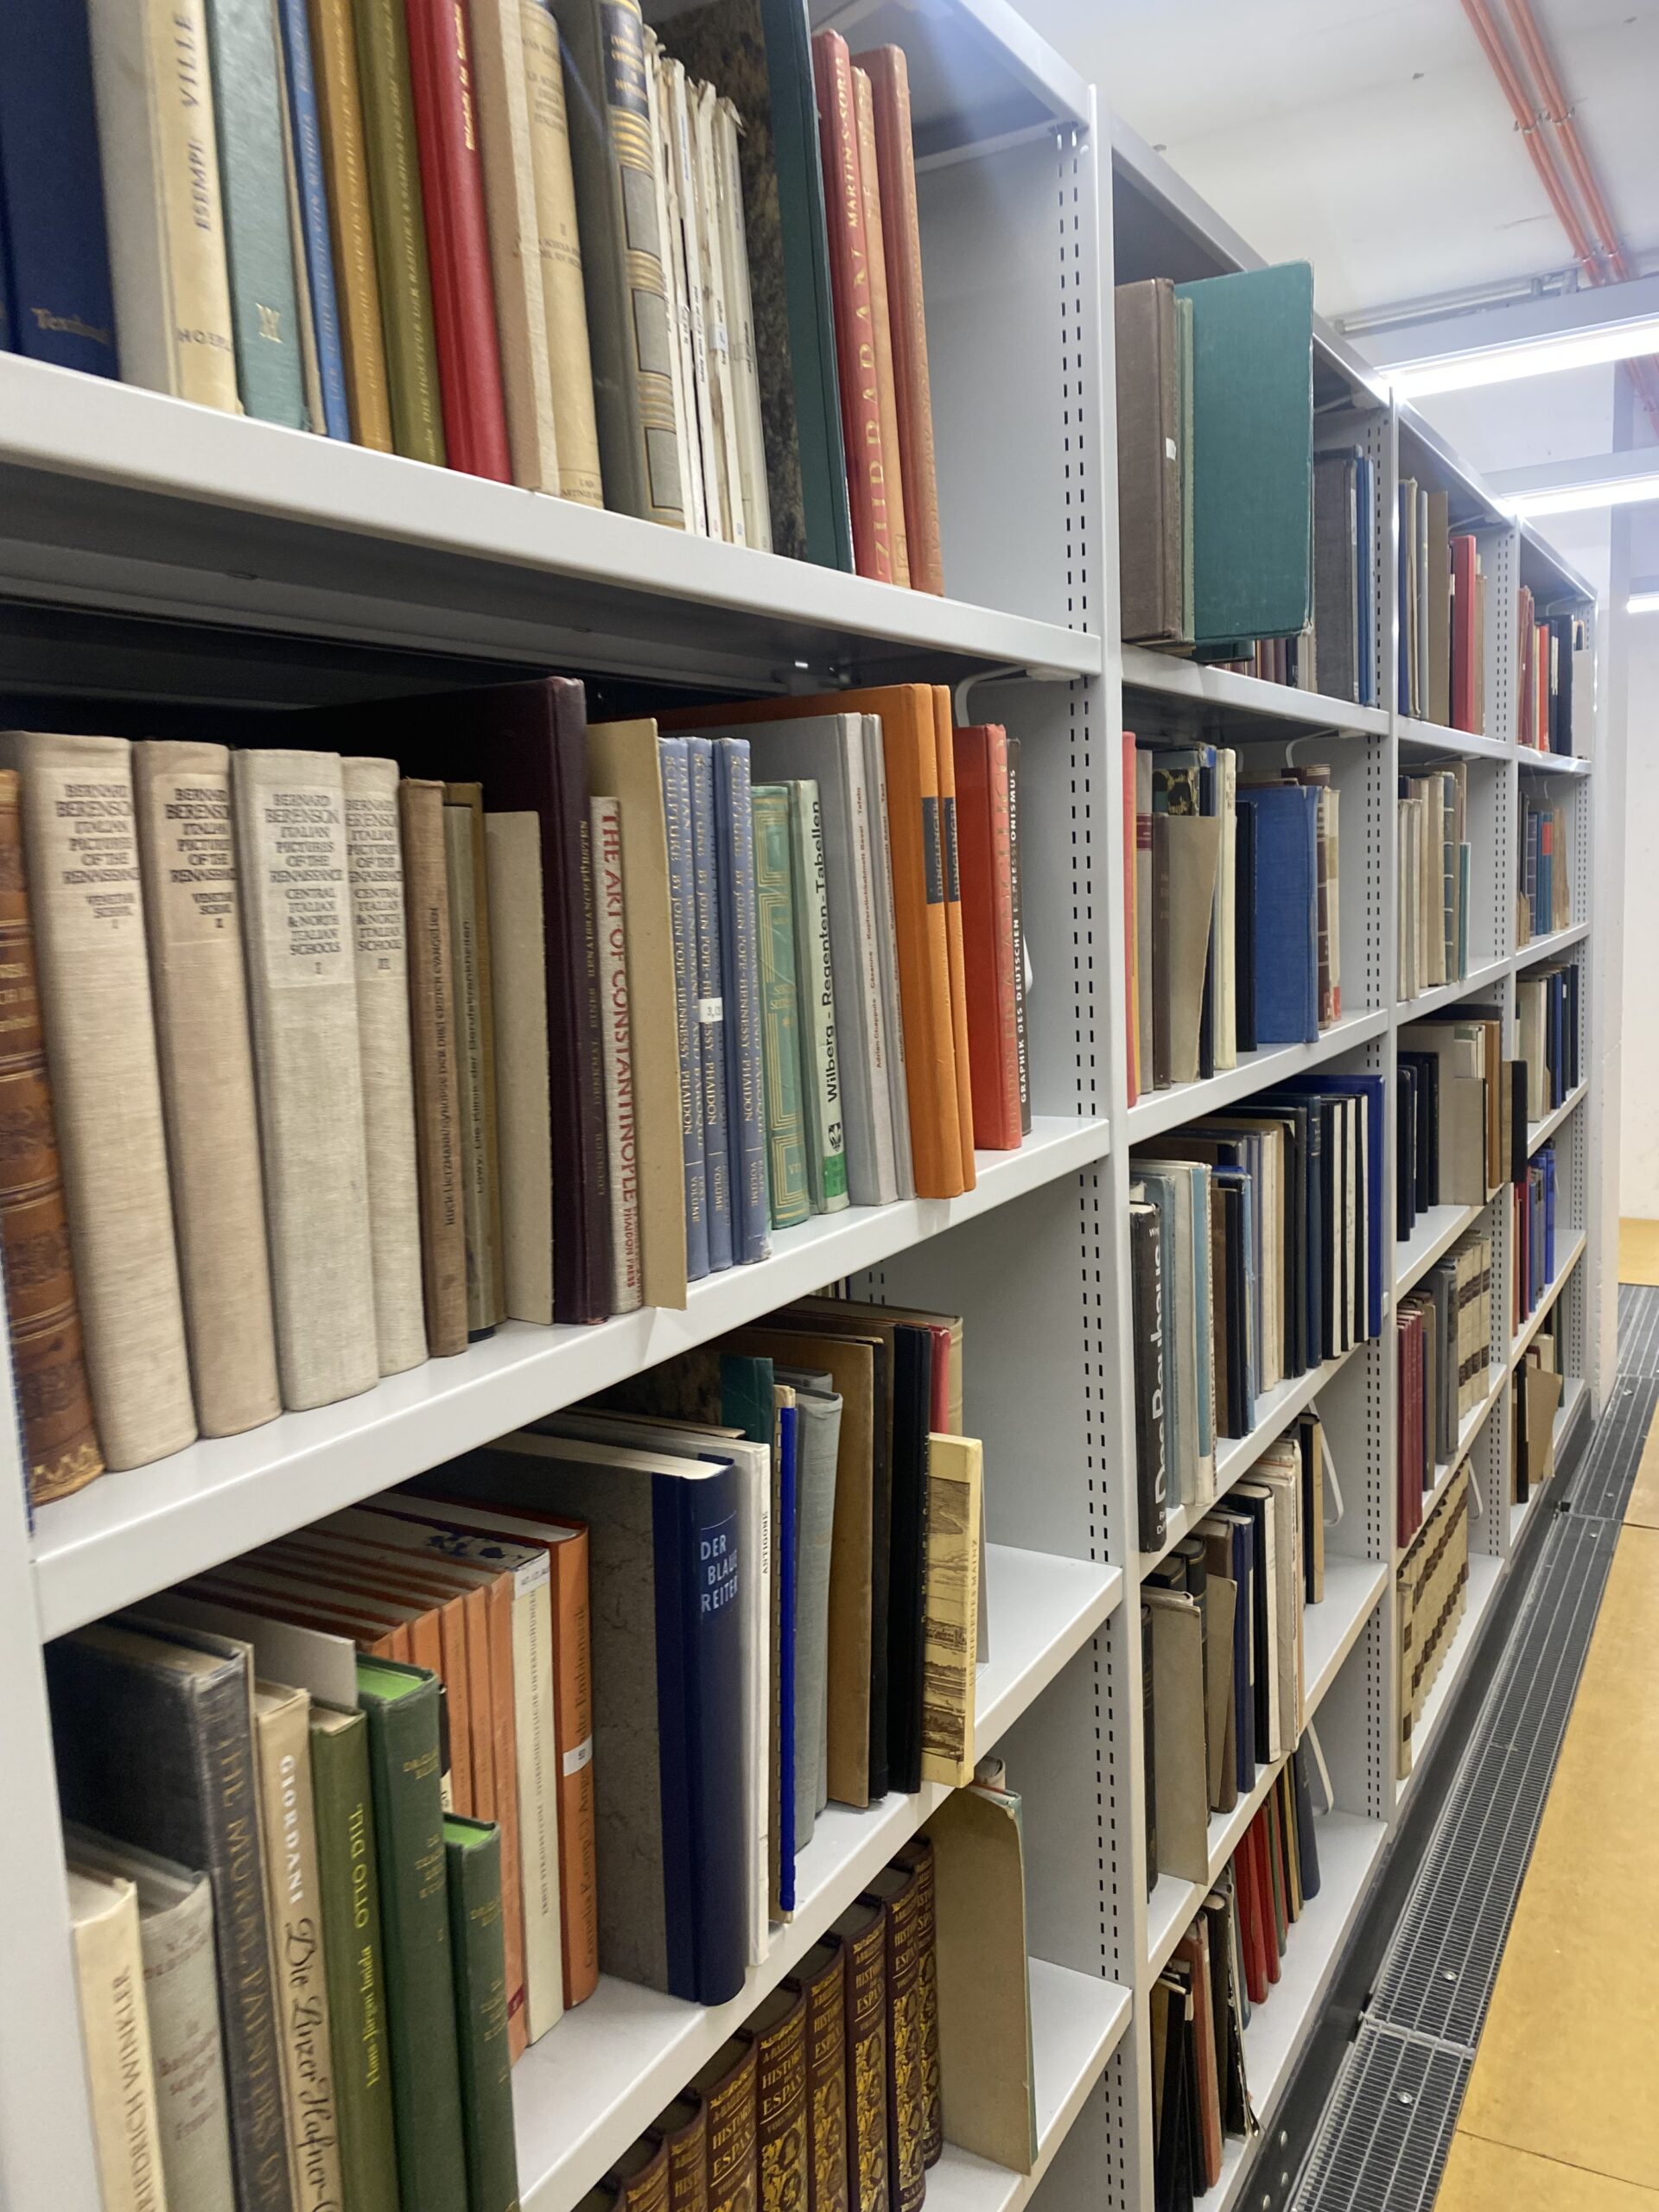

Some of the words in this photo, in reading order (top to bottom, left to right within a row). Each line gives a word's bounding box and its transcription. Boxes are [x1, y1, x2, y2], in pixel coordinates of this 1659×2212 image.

[843, 147, 859, 226] MARTIN
[265, 808, 340, 823] BERENSON
[273, 794, 331, 806] BERNARD
[664, 755, 681, 862] SCULPTURE
[730, 754, 744, 858] SCULPTURE
[276, 842, 334, 853] PICTURES
[281, 827, 331, 838] ITALIAN
[601, 812, 620, 862] THE
[931, 800, 944, 902] DINGLINGER
[950, 799, 960, 901] DINGLINGER
[1008, 768, 1019, 913] EXPRESSIONISMUS
[82, 853, 103, 866] OF
[105, 852, 130, 865] THE
[188, 854, 208, 866] OF
[210, 854, 229, 865] THE
[269, 869, 344, 883] RENAISSANCE
[285, 855, 306, 867] OF
[308, 855, 330, 866] THE
[356, 858, 374, 868] OF
[377, 857, 395, 867] THE
[672, 874, 683, 892] BY
[697, 868, 708, 885] BY
[734, 869, 745, 887] BY
[285, 888, 337, 899] CENTRAL
[289, 901, 337, 912] ITALIAN
[605, 869, 623, 918] ART
[671, 897, 683, 937] JOHN
[698, 890, 709, 931] JOHN
[734, 889, 747, 931] JOHN
[289, 943, 341, 955] SCHOOLS
[291, 929, 338, 941] ITALIAN
[608, 926, 626, 962] OF
[1013, 919, 1022, 1001] DEUTSCHEN
[676, 941, 690, 1059] POPE-HENNESSY
[737, 935, 751, 1048] POPE-HENNESSY
[1016, 1007, 1025, 1033] DES
[611, 969, 637, 1202] CONSTANTINOPLE
[824, 1025, 839, 1103] Wilberg
[1018, 1040, 1028, 1103] GRAPHIK
[681, 1070, 693, 1135] PHAIDON
[706, 1061, 716, 1126] PHAIDON
[742, 1058, 753, 1122] PHAIDON
[1006, 1050, 1018, 1135] PHAIDON
[690, 1175, 701, 1223] VOLUME
[715, 1166, 724, 1211] VOLUME
[749, 1160, 759, 1207] VOLUME
[623, 1206, 635, 1256] PHAIDON
[626, 1258, 637, 1288] PRESS
[701, 1535, 727, 1560] DER
[968, 1590, 976, 1687] GEPRIESENES
[279, 1754, 303, 1905] GIORDANI
[347, 1802, 366, 1861] DILL
[226, 1816, 257, 1965] MURAL
[351, 1864, 369, 1930] OTTO
[284, 1916, 318, 1988] Die
[112, 1967, 142, 2092] WINKLER
[289, 1995, 327, 2084] Linzer
[241, 1967, 282, 2152] PAINTERS
[255, 2152, 282, 2202] OF
